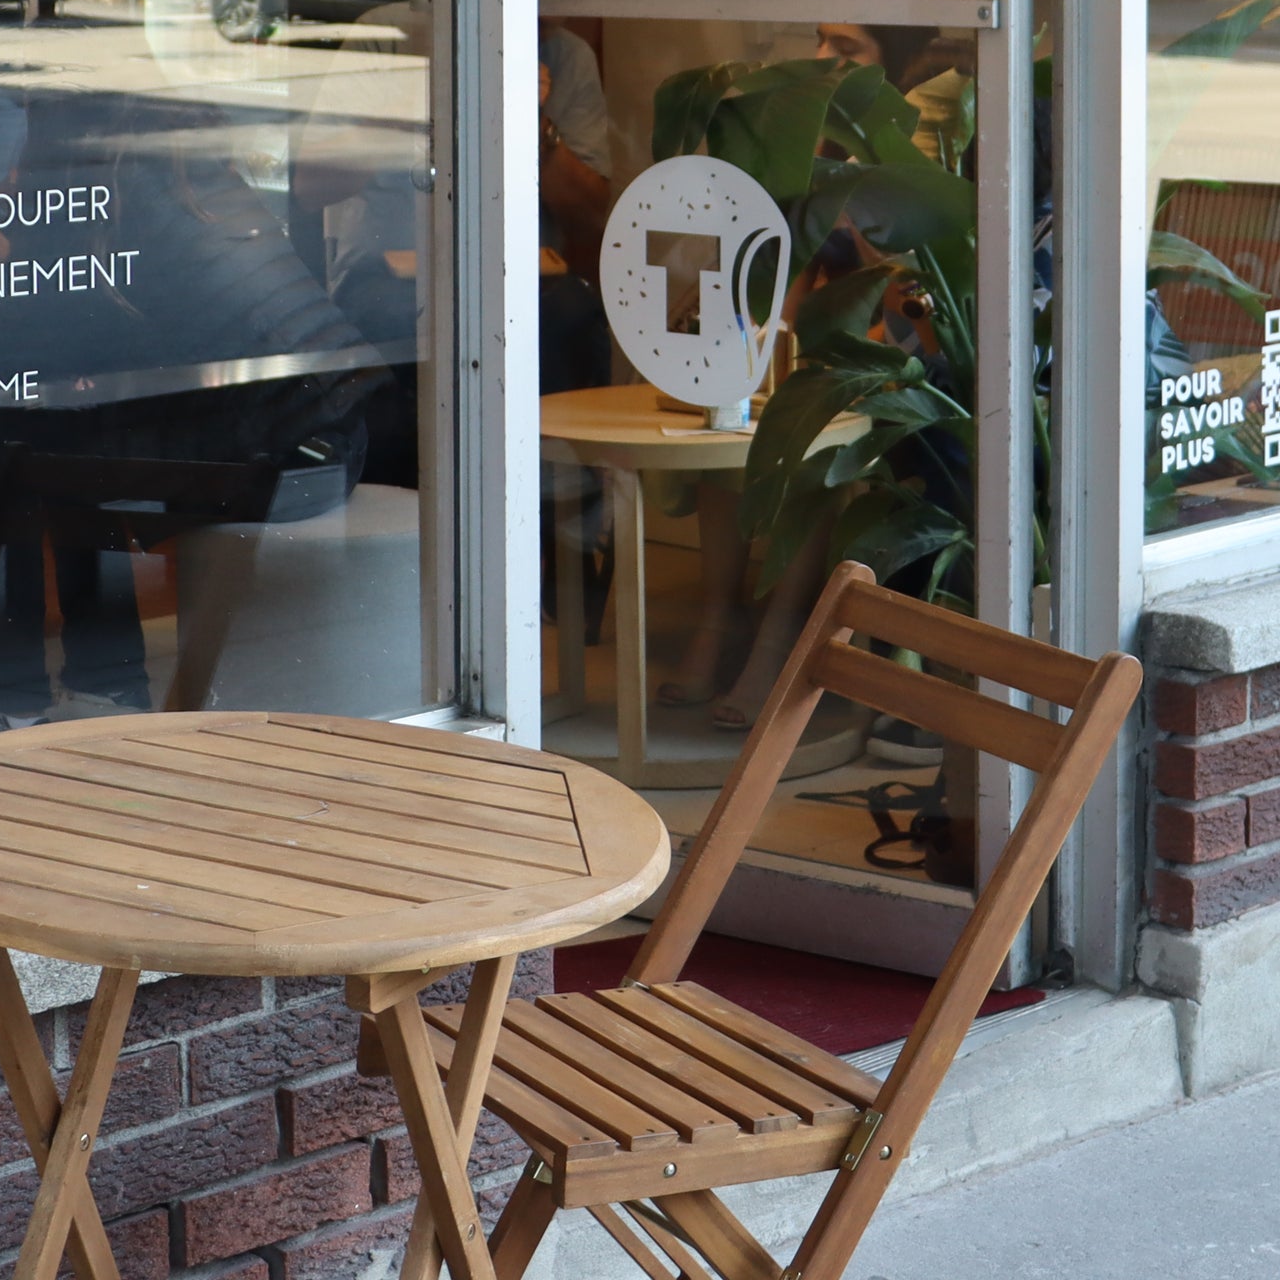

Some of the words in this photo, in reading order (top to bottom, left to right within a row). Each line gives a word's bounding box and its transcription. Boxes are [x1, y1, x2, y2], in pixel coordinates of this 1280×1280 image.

[1160, 368, 1221, 407] POUR
[1160, 396, 1244, 441] SAVOIR
[1161, 443, 1215, 475] PLUS
